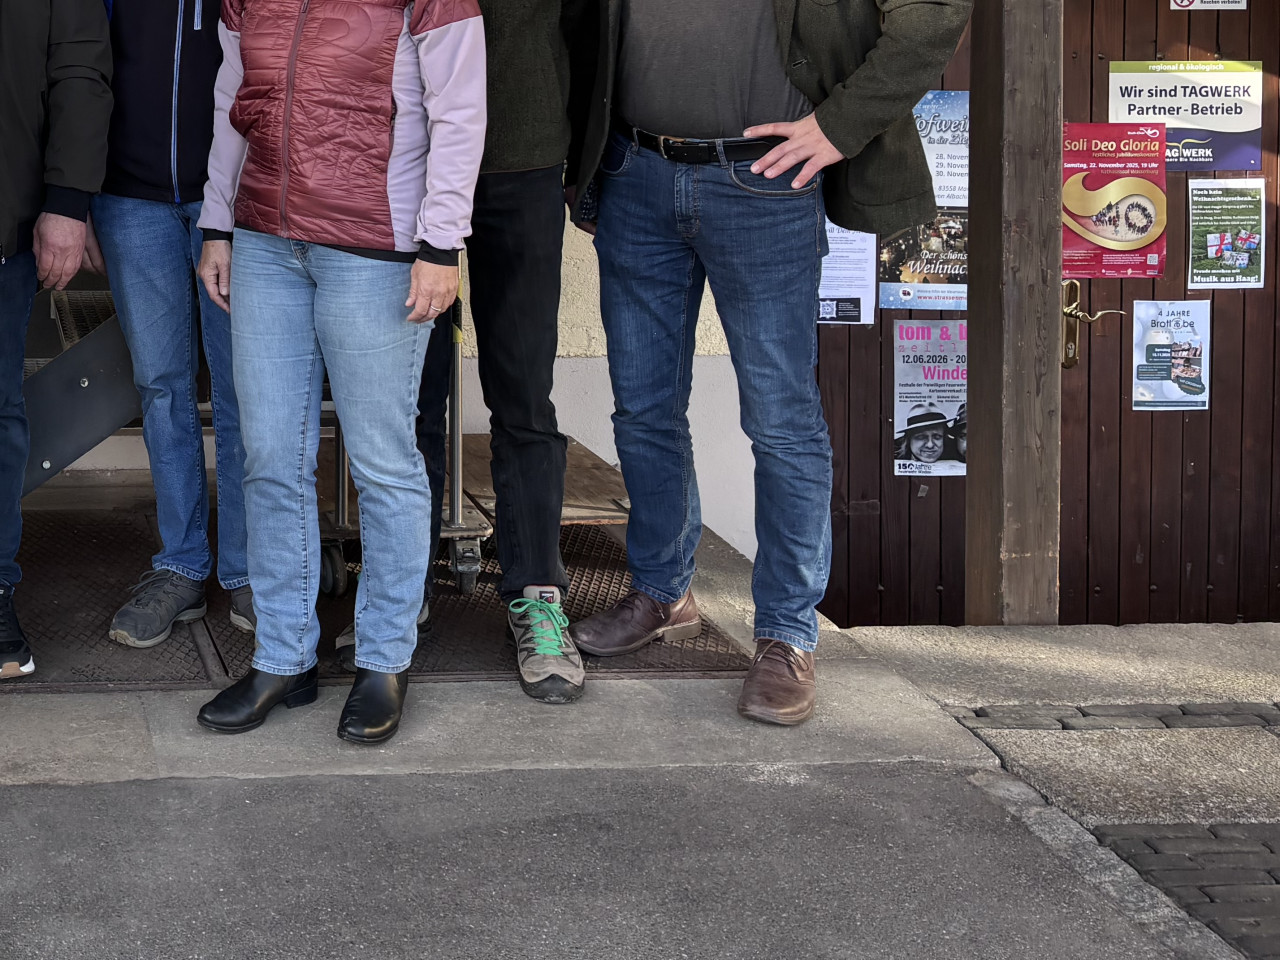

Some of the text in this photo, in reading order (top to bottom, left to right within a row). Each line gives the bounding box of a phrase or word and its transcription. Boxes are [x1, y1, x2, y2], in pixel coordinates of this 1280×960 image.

[1149, 63, 1178, 71] regional
[1186, 63, 1224, 71] ökologisch
[1120, 85, 1251, 98] Wir sind TAGWERK
[914, 113, 969, 138] ofwei
[949, 133, 969, 146] Zie
[1064, 139, 1159, 151] Soli Deo Gloria
[1166, 148, 1213, 158] AGWERK
[920, 250, 937, 259] Der
[908, 260, 968, 274] Weihnac
[1193, 275, 1258, 283] Musik aus Haag!
[899, 324, 932, 341] tom
[940, 326, 952, 341] &
[898, 342, 967, 353] zeitl
[902, 354, 948, 364] 12.06.2026
[955, 354, 966, 364] 20
[922, 365, 968, 380] Winde
